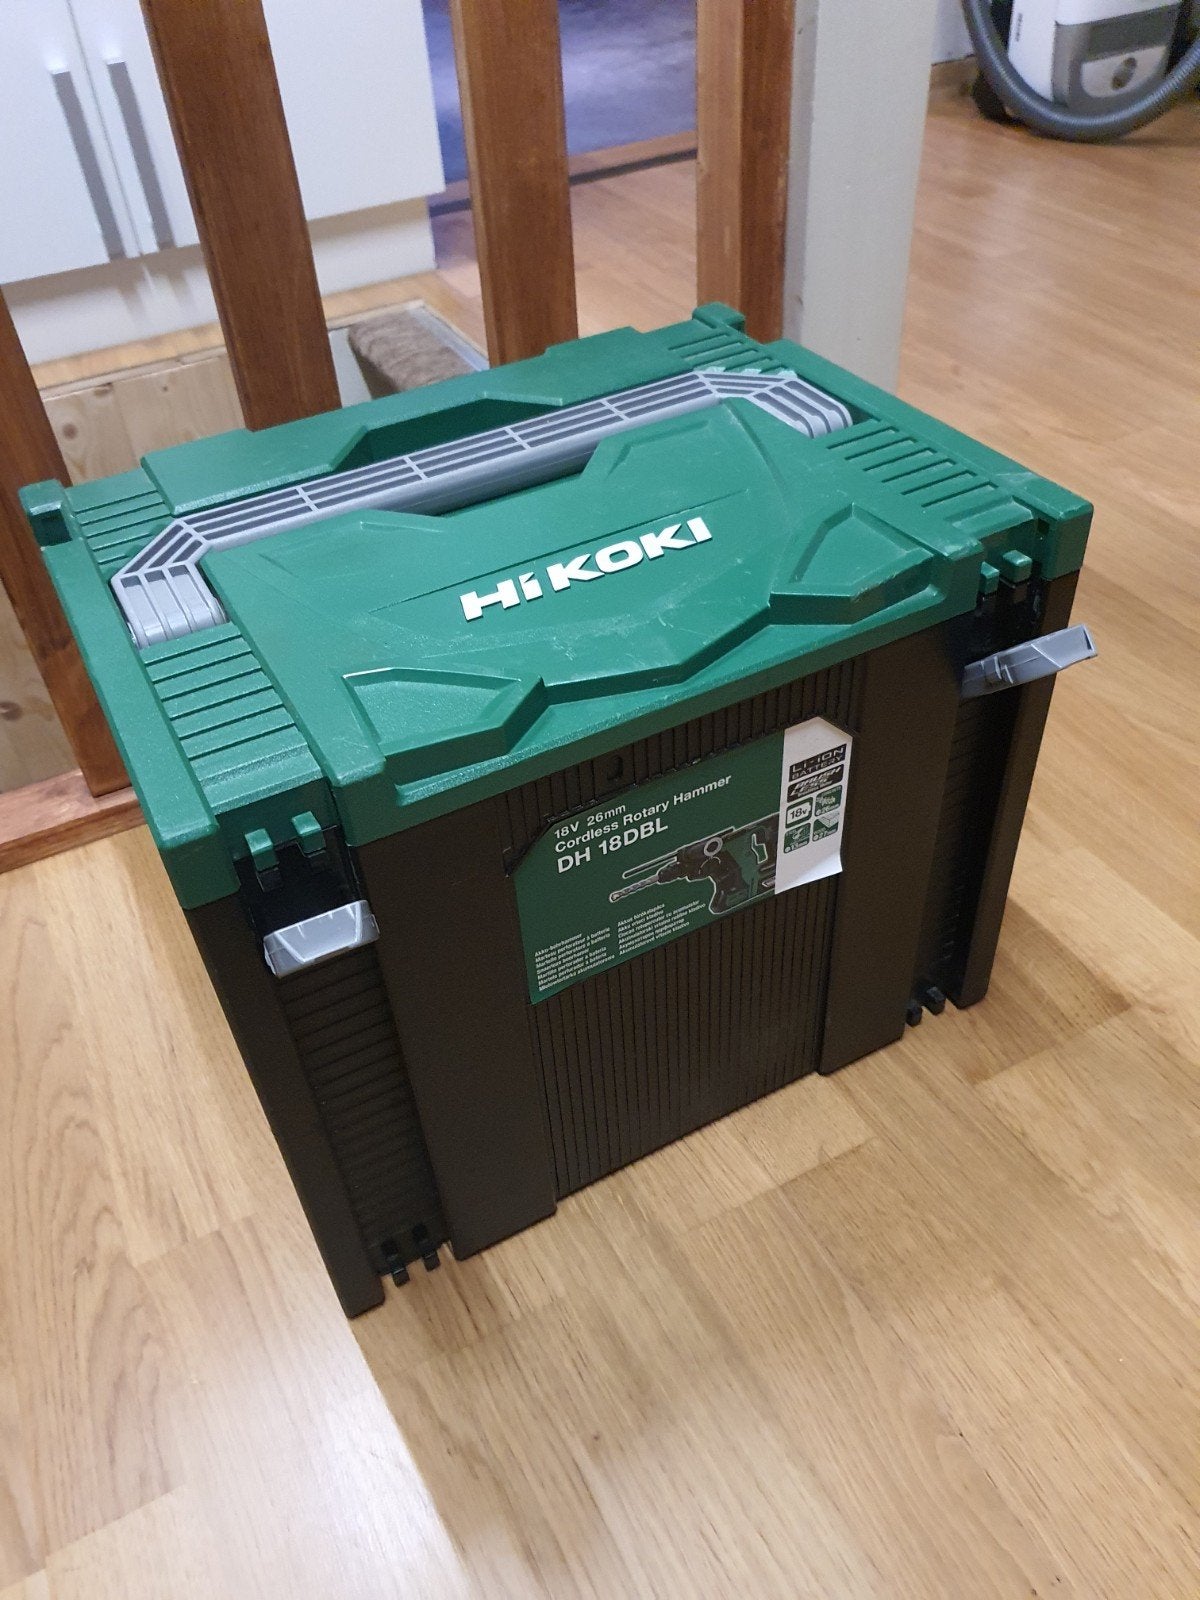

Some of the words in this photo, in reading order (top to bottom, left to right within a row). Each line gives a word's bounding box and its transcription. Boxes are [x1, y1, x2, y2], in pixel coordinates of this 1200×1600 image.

[792, 756, 843, 778] BATTERY
[554, 821, 579, 839] 18V
[587, 804, 626, 826] 26mm
[555, 821, 618, 852] Cordless
[623, 801, 669, 826] Rotary
[674, 775, 731, 805] Hammer
[557, 848, 591, 873] DH
[599, 818, 668, 855] 18DBL
